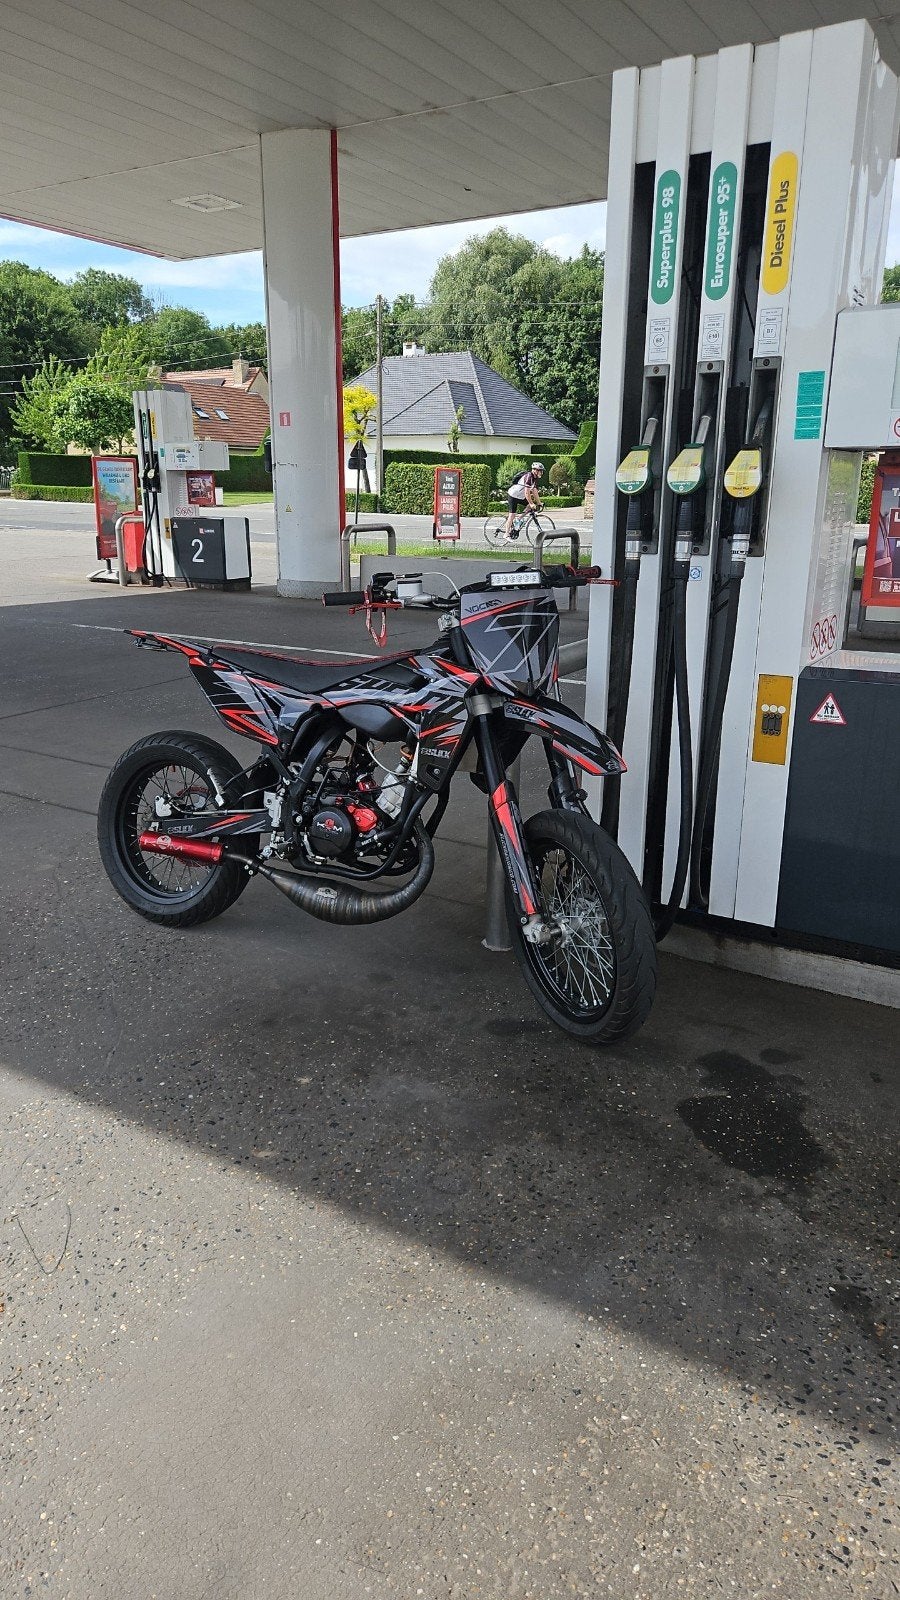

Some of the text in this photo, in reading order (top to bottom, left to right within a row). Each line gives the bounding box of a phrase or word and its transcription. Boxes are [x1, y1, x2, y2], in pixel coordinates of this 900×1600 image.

[656, 186, 675, 289] Superplus 98
[710, 176, 731, 288] Eurosuper 95+
[769, 180, 790, 268] Diesel Plus
[191, 538, 205, 563] 2
